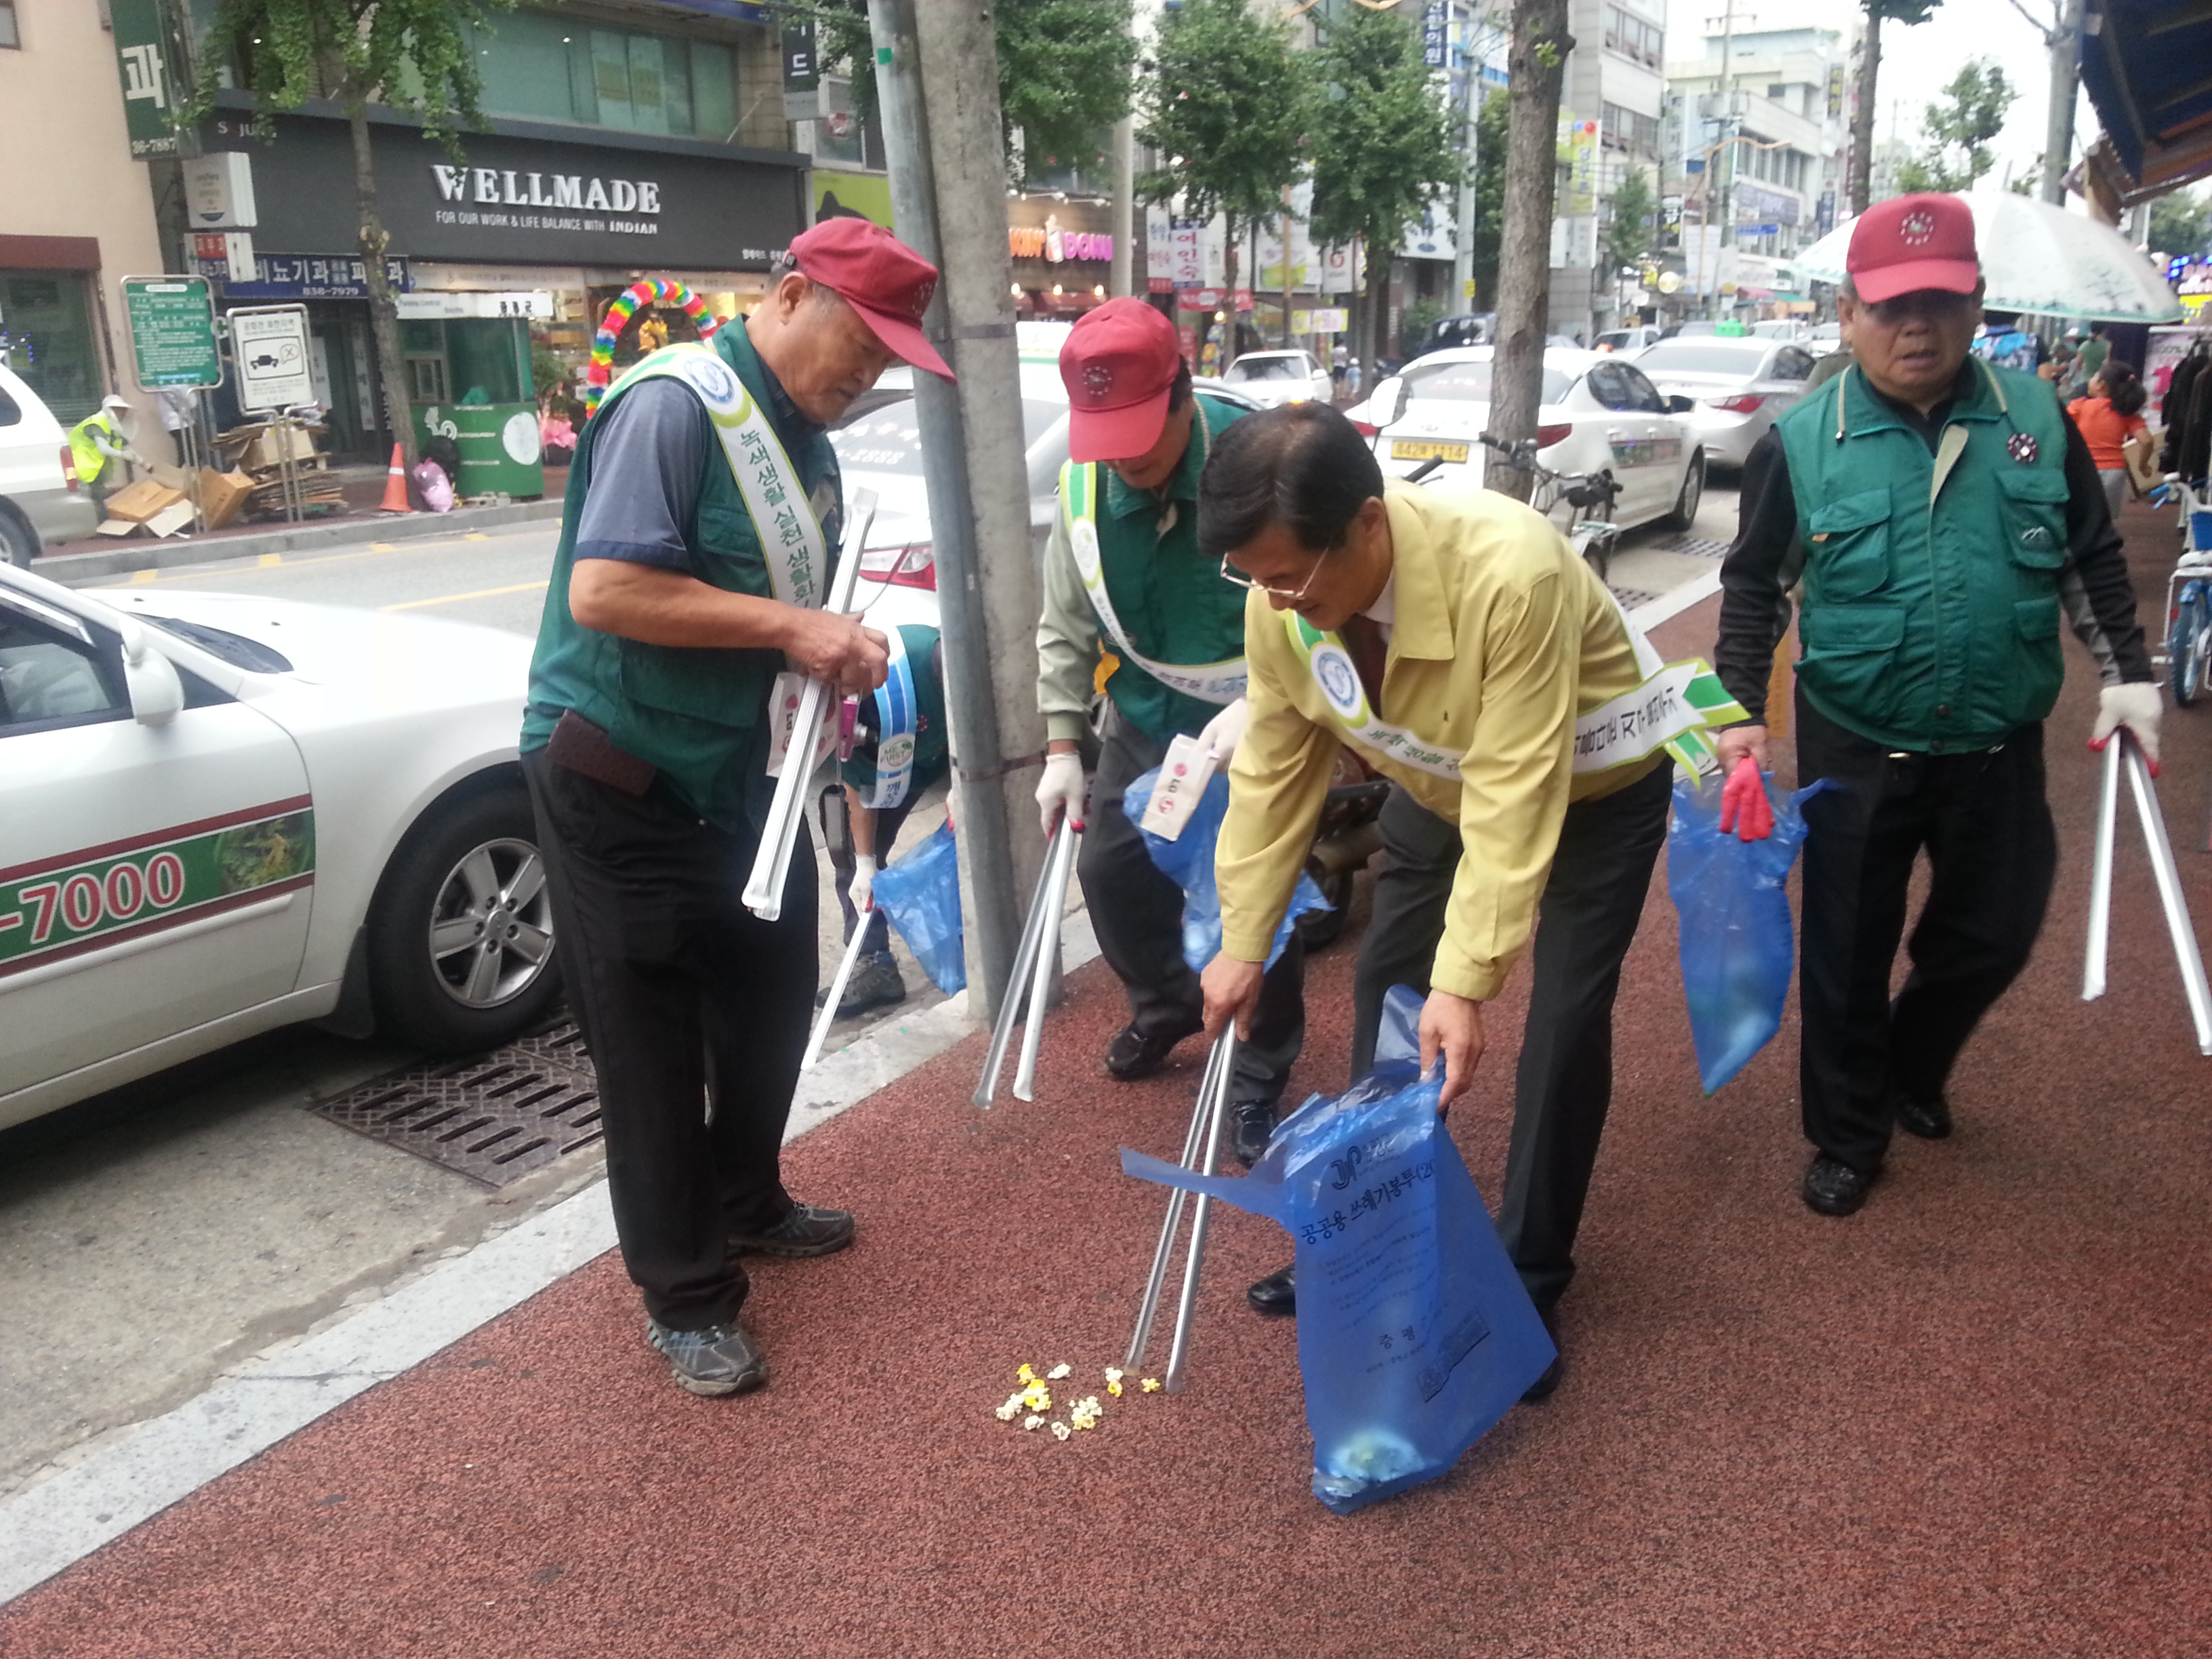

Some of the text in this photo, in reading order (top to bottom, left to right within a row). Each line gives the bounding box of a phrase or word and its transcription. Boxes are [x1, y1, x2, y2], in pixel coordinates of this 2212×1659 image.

[121, 43, 165, 108] 과
[430, 164, 661, 214] WELLMADE
[436, 210, 658, 234] FOR OUR WORK & LIFE BALANCE WITH INDIAN
[350, 261, 404, 285] 피과
[740, 430, 787, 507] 녹색생활
[774, 504, 804, 548] 실천
[1300, 1210, 1347, 1245] 공공용
